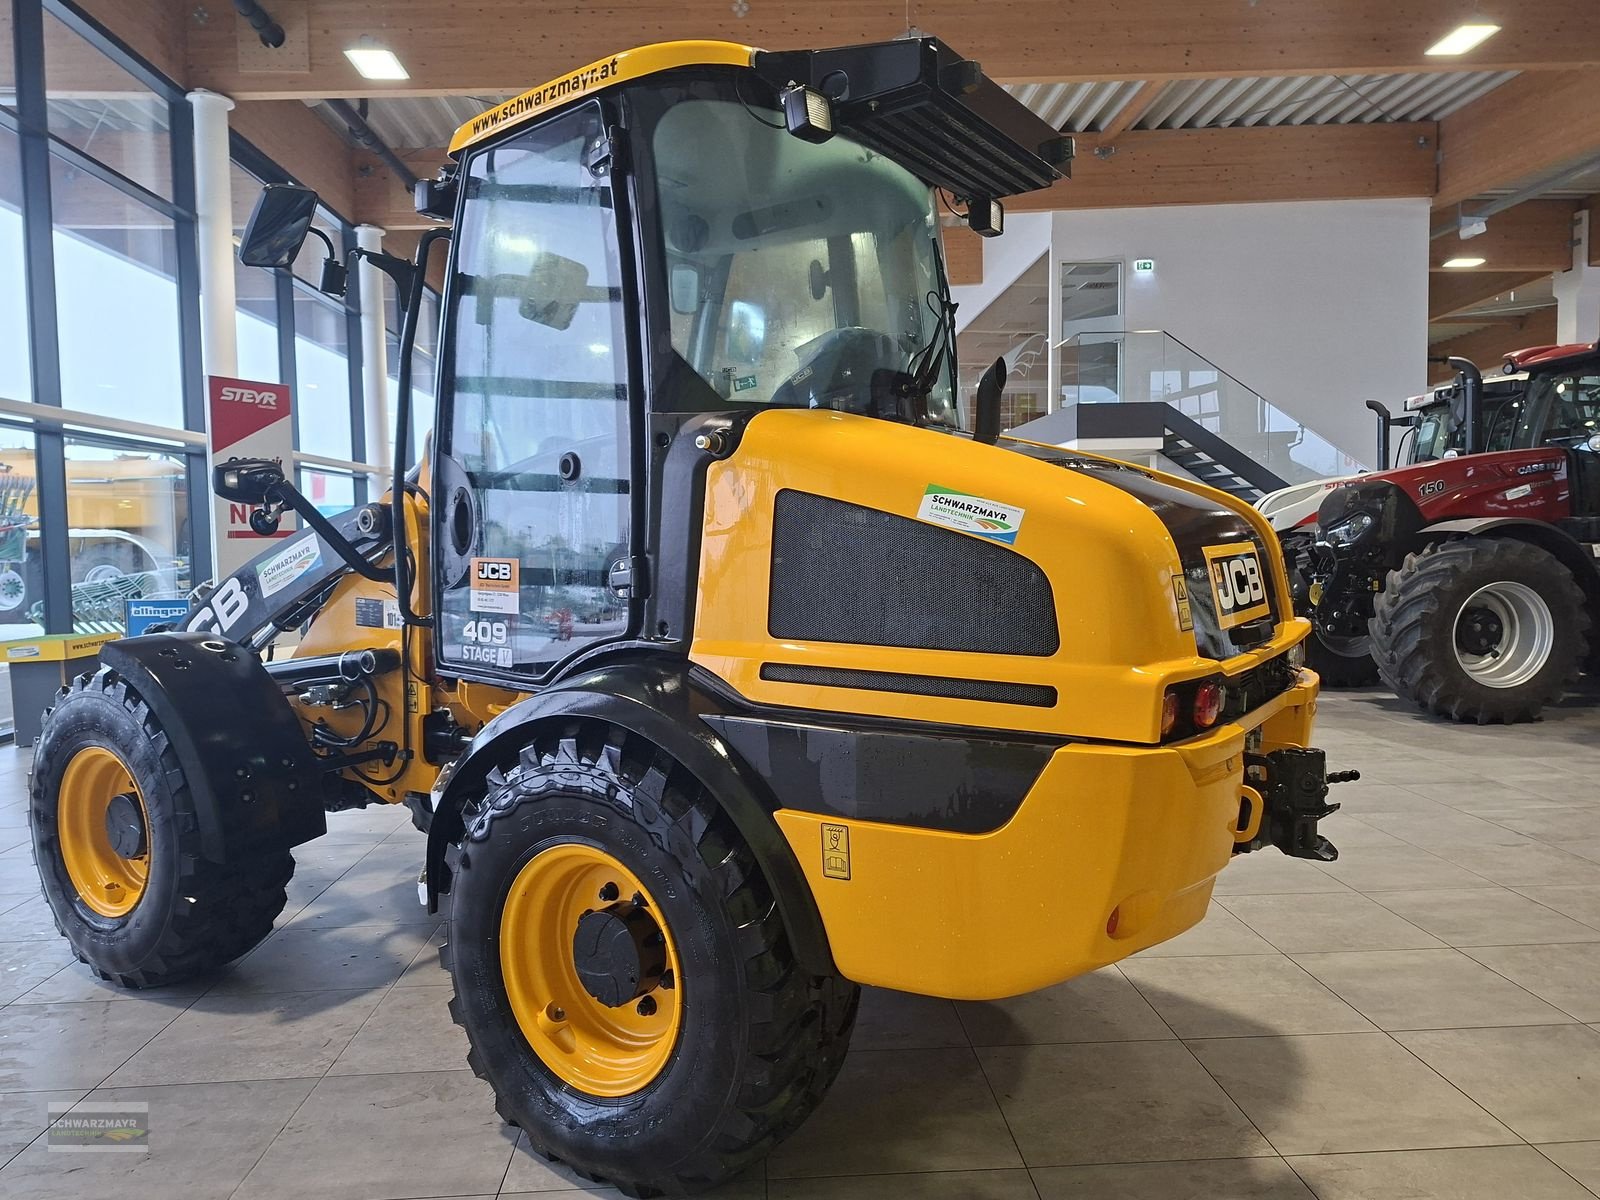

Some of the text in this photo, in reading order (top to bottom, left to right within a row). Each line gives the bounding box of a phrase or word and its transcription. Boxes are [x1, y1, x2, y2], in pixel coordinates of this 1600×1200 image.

[472, 58, 618, 135] www.schwarzmayr.at
[220, 387, 277, 405] STEYR
[1517, 463, 1545, 475] CASE
[1418, 479, 1445, 496] 150
[930, 504, 974, 521] LANDTECHNIK
[932, 494, 1008, 522] SCHWARZMAYR
[263, 546, 310, 578] SCHWARZMAYR
[478, 562, 511, 580] JCB
[1213, 556, 1264, 610] JCB
[462, 620, 507, 644] 409
[462, 645, 497, 664] STAGE
